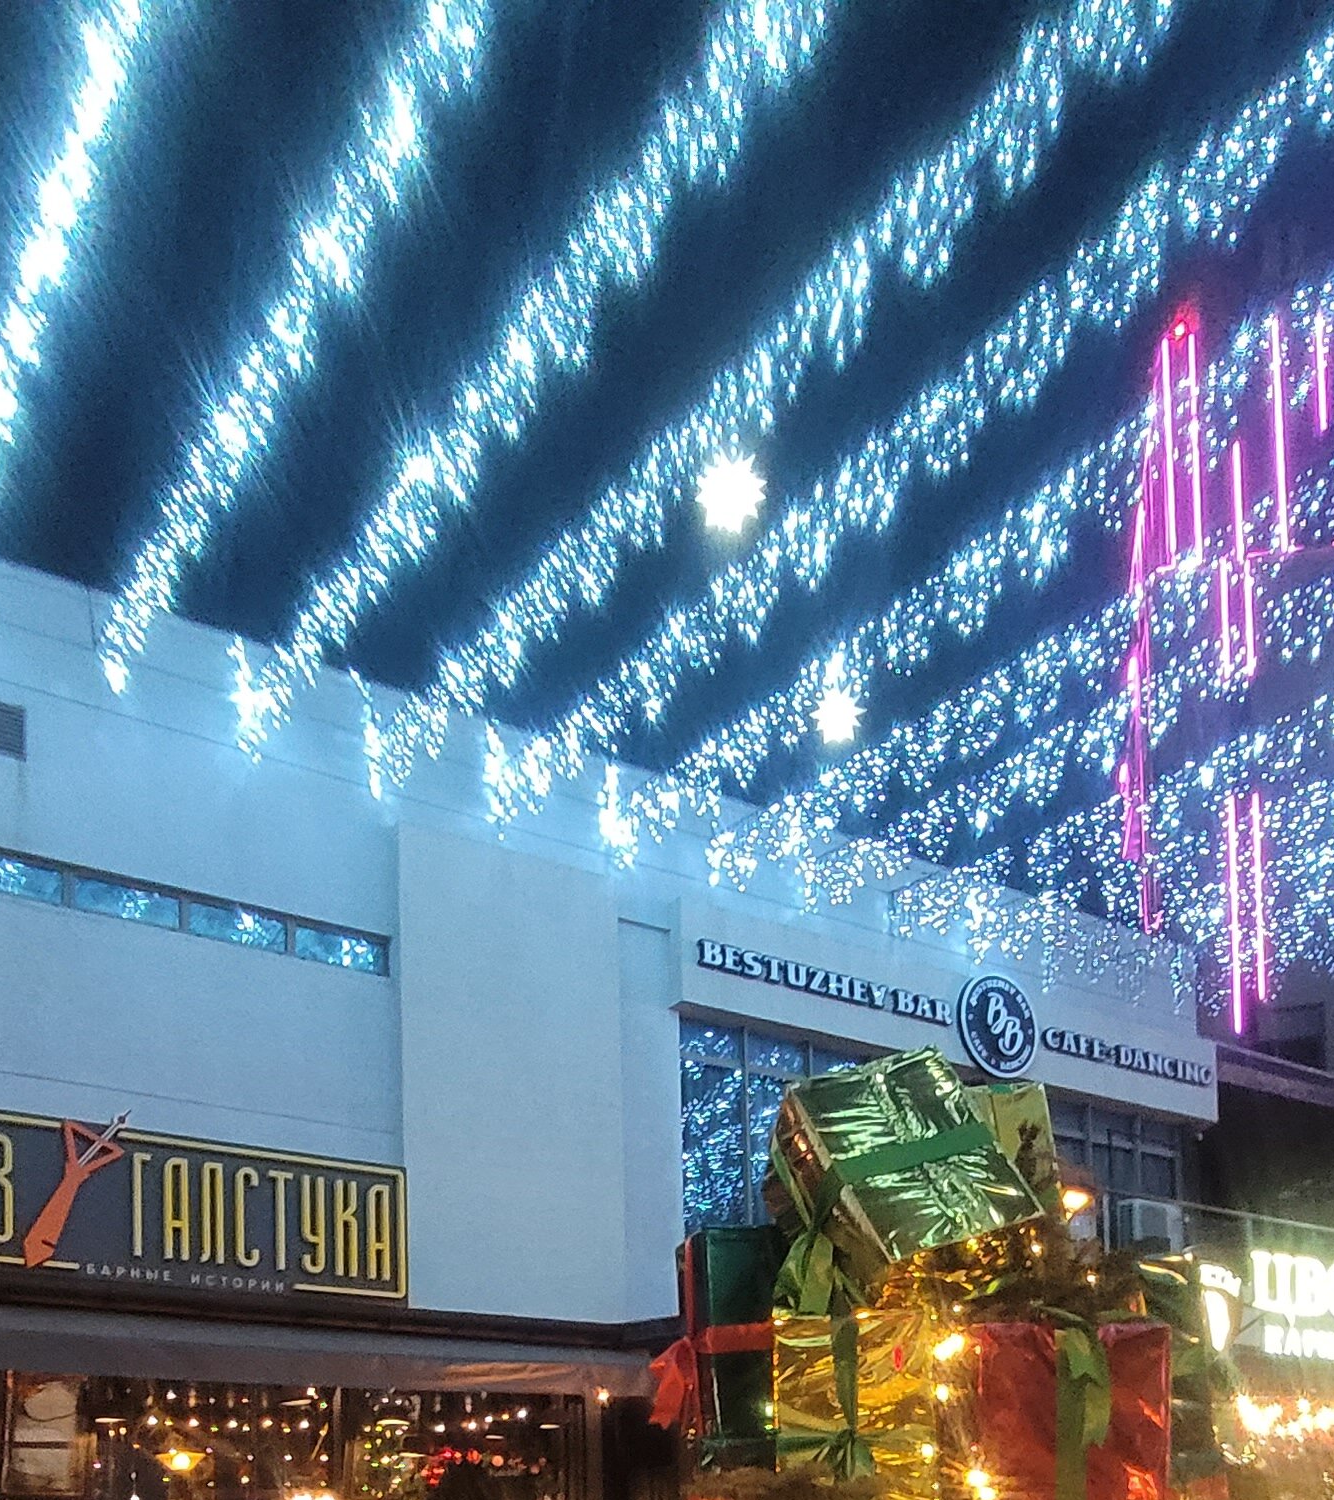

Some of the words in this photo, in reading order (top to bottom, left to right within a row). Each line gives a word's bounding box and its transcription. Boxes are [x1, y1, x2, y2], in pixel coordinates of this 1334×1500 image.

[897, 990, 954, 1025] BAR
[131, 1152, 392, 1282] ГАЛСТУКА
[86, 1263, 173, 1282] БАРНЫЕ
[190, 1274, 286, 1293] ИСТОРИИ
